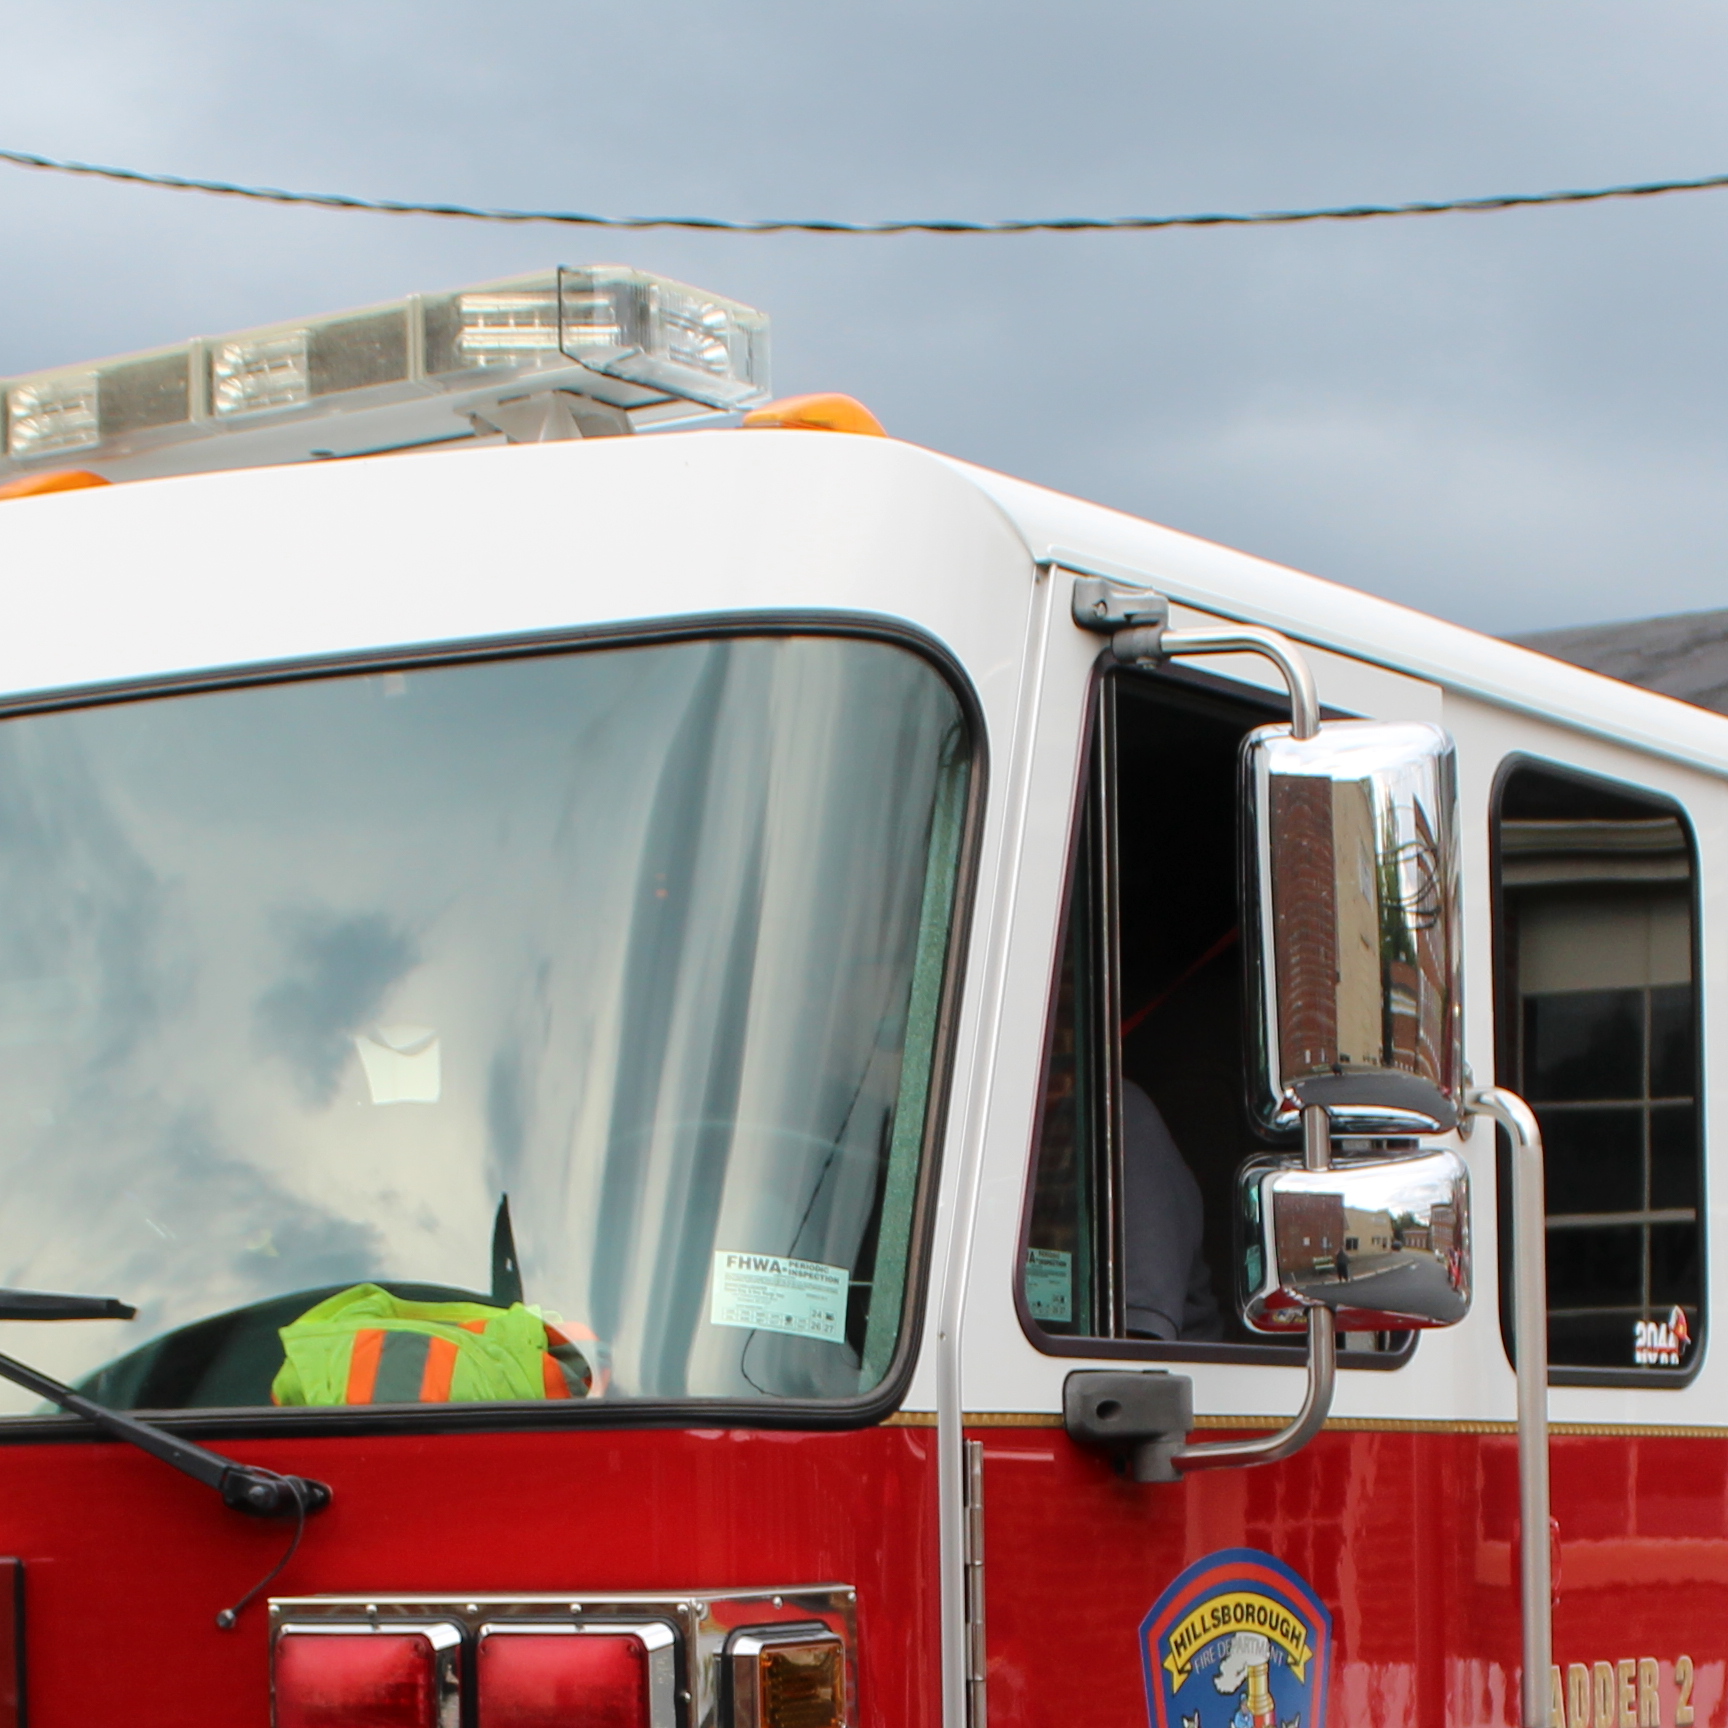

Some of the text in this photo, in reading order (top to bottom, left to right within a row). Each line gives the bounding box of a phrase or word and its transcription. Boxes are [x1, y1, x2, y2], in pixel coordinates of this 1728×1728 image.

[726, 1254, 782, 1274] FHWA
[788, 1269, 840, 1285] INSPECTION
[1173, 1602, 1303, 1659] HILLSBOROUGH
[1194, 1645, 1216, 1675] FIRE
[1675, 1654, 1695, 1728] 2
